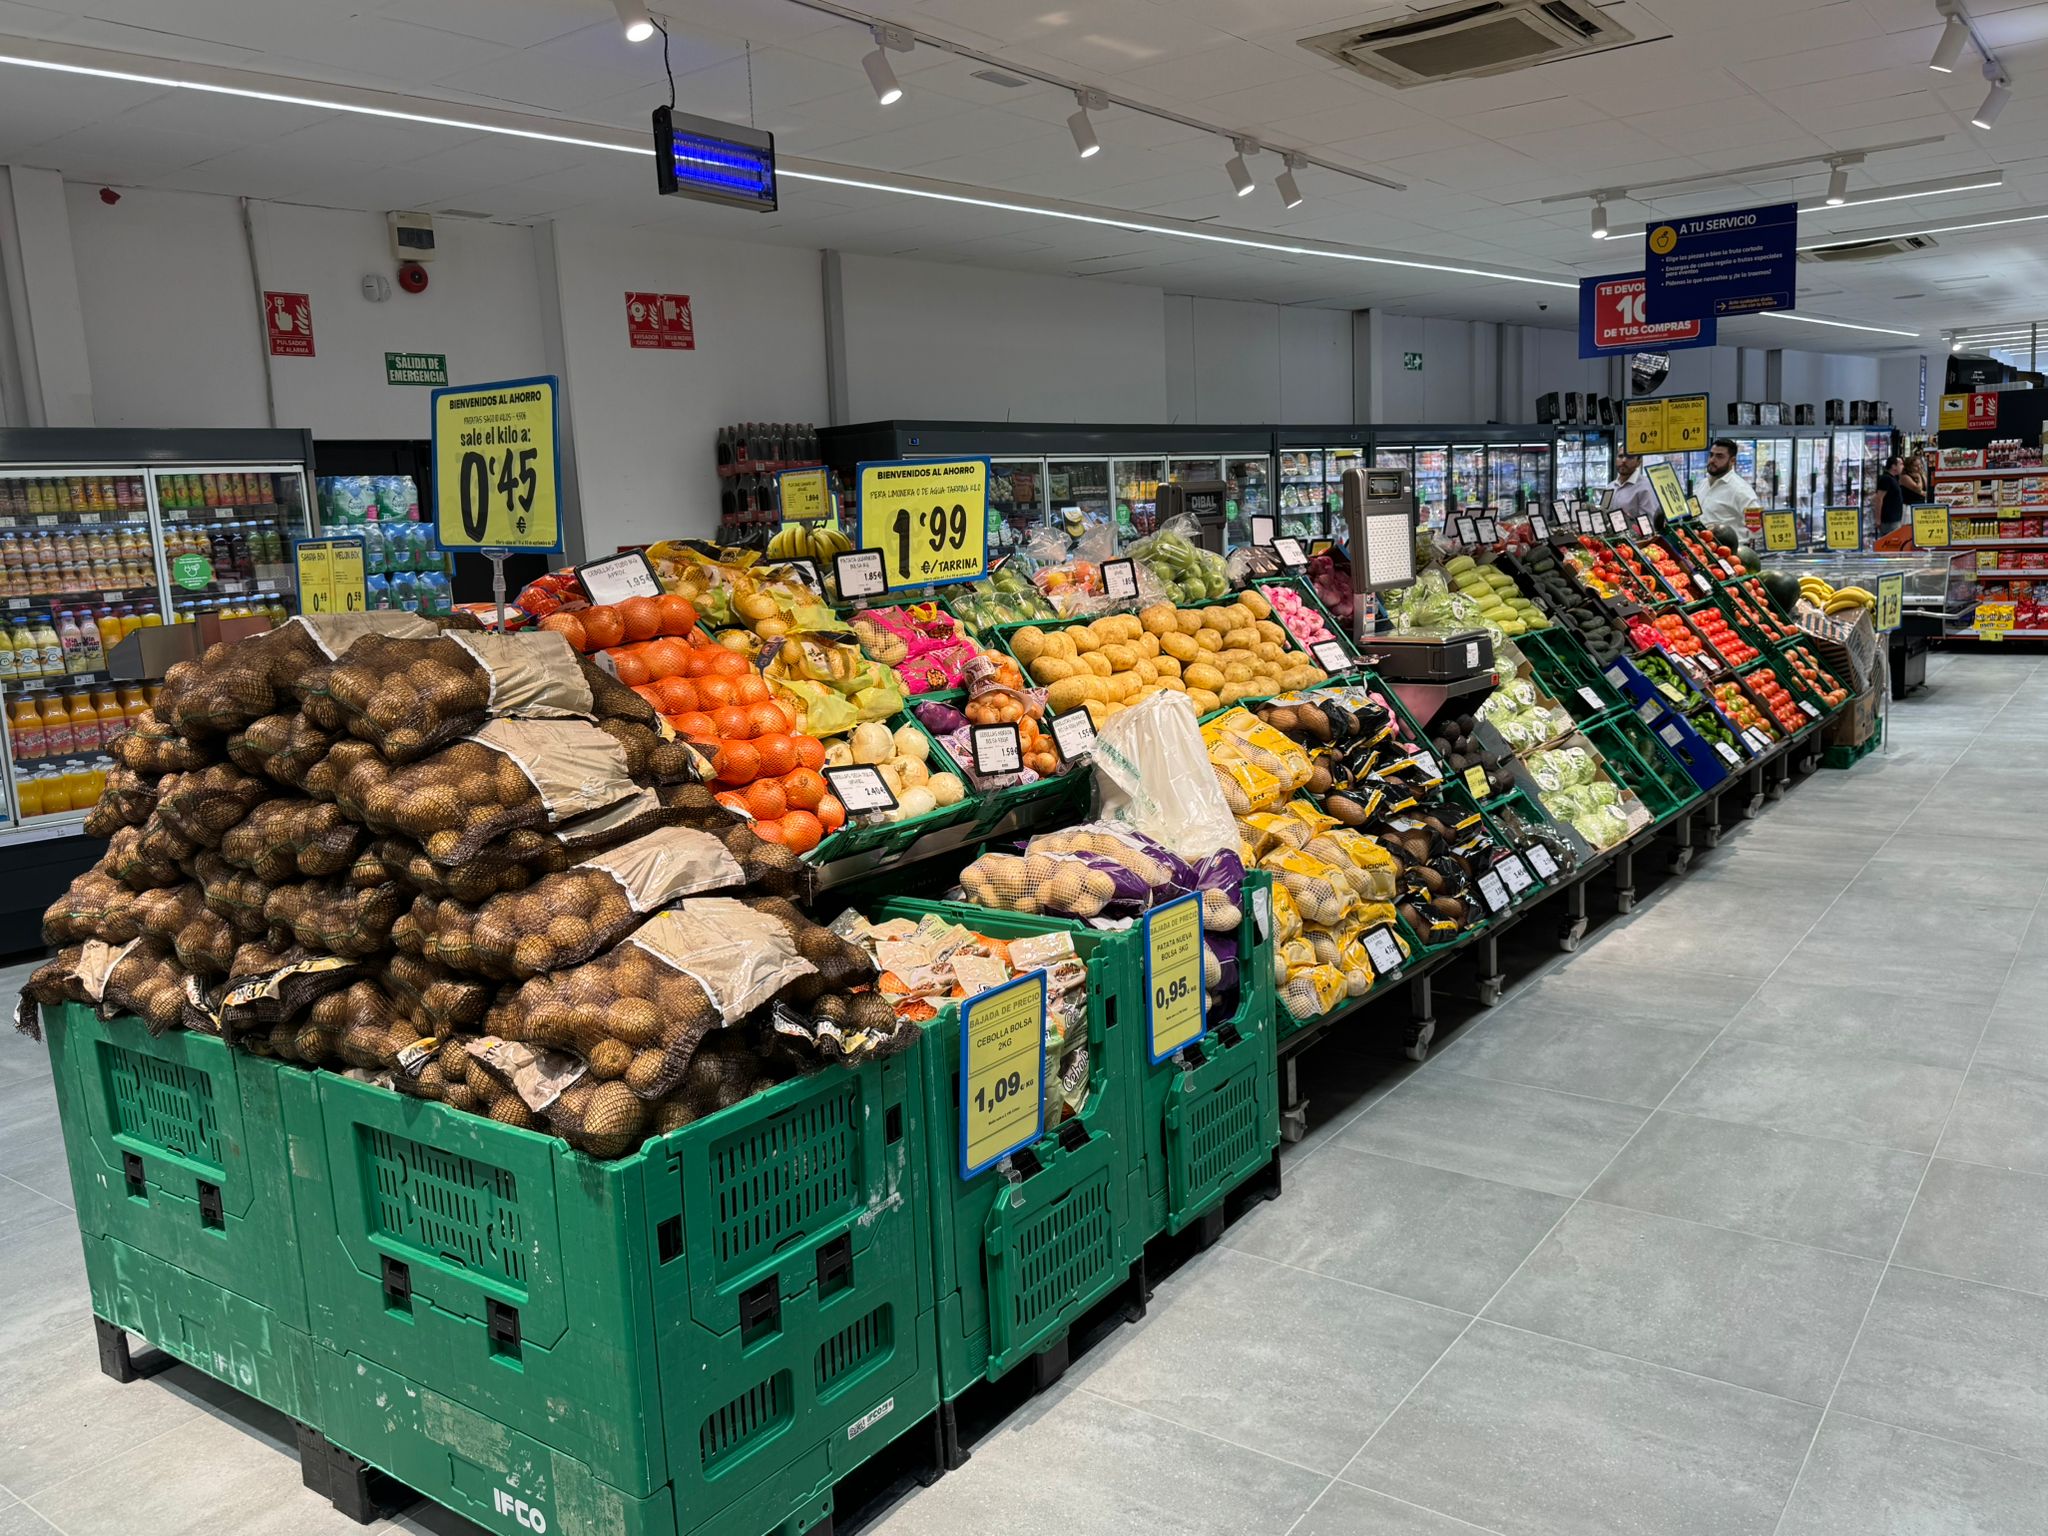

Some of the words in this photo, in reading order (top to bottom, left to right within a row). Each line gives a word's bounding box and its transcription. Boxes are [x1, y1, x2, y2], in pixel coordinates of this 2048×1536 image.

[1680, 224, 1688, 234] A
[1690, 221, 1704, 233] TU
[1706, 214, 1757, 231] SERVICIO
[1754, 252, 1783, 262] especiales
[1600, 286, 1613, 296] TE
[1604, 328, 1617, 338] DE
[1619, 326, 1639, 336] TUS
[1640, 320, 1692, 334] COMPRAS
[395, 357, 427, 370] SALIDA
[428, 358, 440, 370] DE
[389, 369, 446, 383] EMERGENCIA
[450, 395, 498, 410] BIENVENIDOS
[499, 393, 509, 405] AL
[509, 391, 542, 404] AHORRO
[460, 425, 483, 446] sale
[485, 426, 495, 445] el
[498, 424, 518, 444] kilo
[520, 427, 531, 443] a:
[877, 469, 931, 480] BIENVENIDOS
[932, 468, 942, 476] AL
[943, 466, 975, 475] AHORRO
[870, 491, 886, 499] PERA
[888, 488, 915, 498] LIMONERA
[922, 488, 928, 496] DE
[929, 487, 945, 495] AGUA
[1191, 495, 1217, 509] DIBAL
[1171, 918, 1178, 927] DE
[1157, 938, 1175, 952] PATATA
[1176, 931, 1193, 944] NUEVA
[1161, 948, 1178, 962] BOLSA
[1156, 975, 1187, 1010] 0,95
[969, 1010, 1000, 1030] BAJADA
[1001, 1005, 1012, 1016] DE
[1012, 991, 1040, 1011] PRECIO
[976, 1026, 1010, 1049] CEBOLLA
[1010, 1016, 1033, 1035] BOLSA
[998, 1038, 1013, 1051] 2KG
[974, 1070, 1021, 1114] 1,09
[1026, 1079, 1034, 1089] KG
[493, 1487, 546, 1534] IFCO
